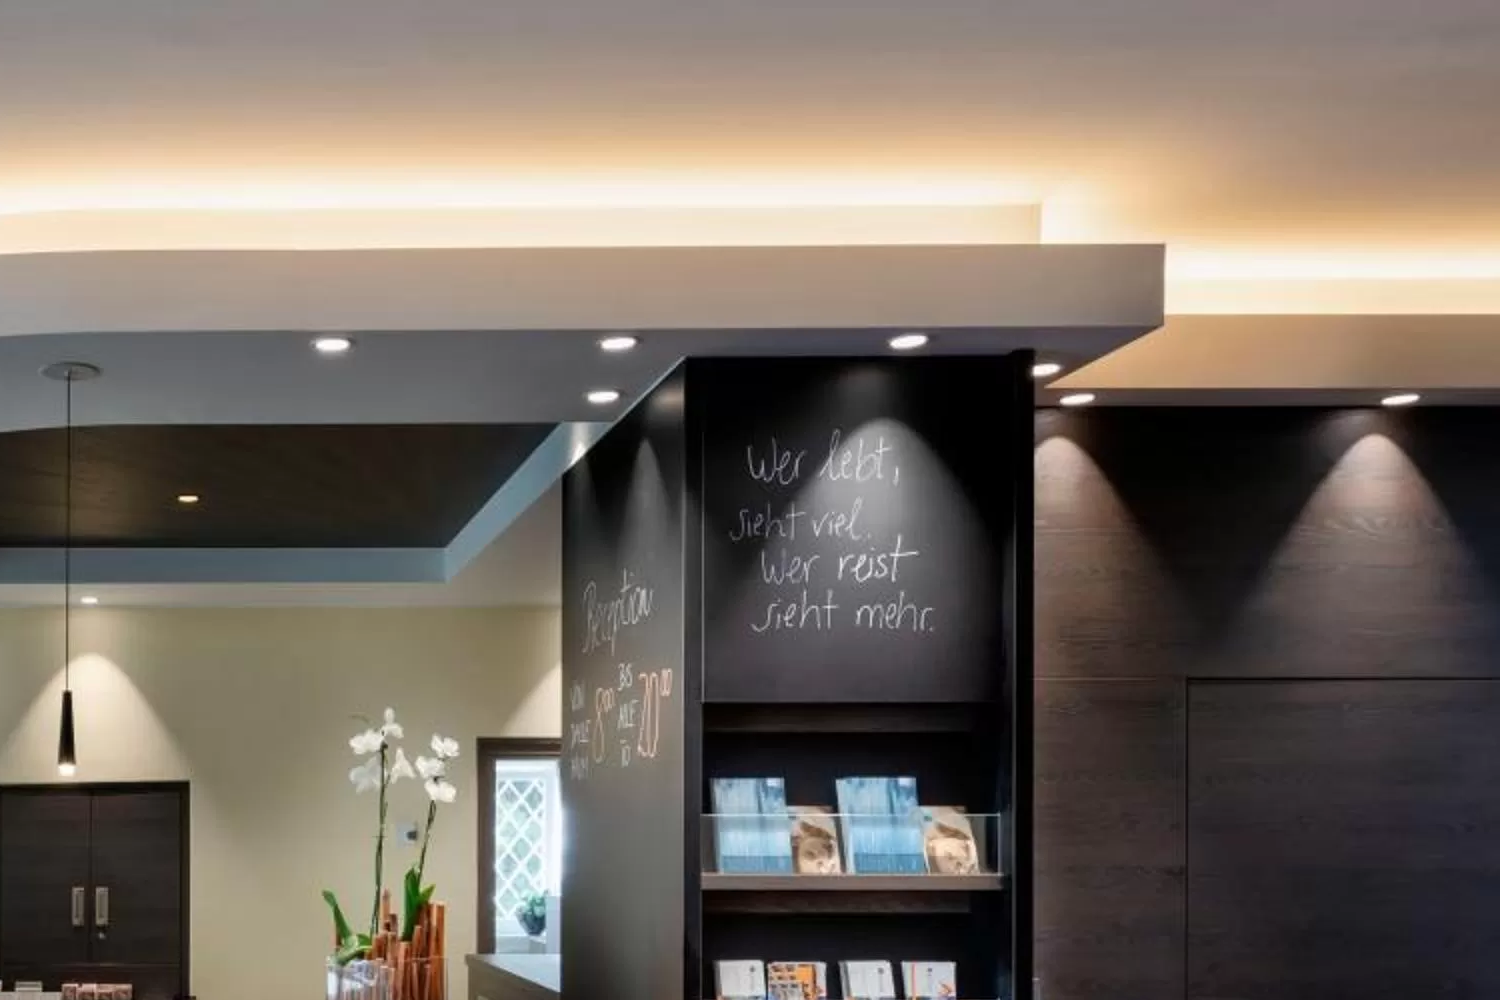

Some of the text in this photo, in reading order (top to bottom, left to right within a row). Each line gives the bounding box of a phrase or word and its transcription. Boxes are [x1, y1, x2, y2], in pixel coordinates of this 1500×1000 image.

[746, 427, 900, 486] Wer lebt,
[729, 503, 807, 542] sieht
[761, 535, 920, 586] Wer reist
[750, 590, 935, 633] sieht mehr.
